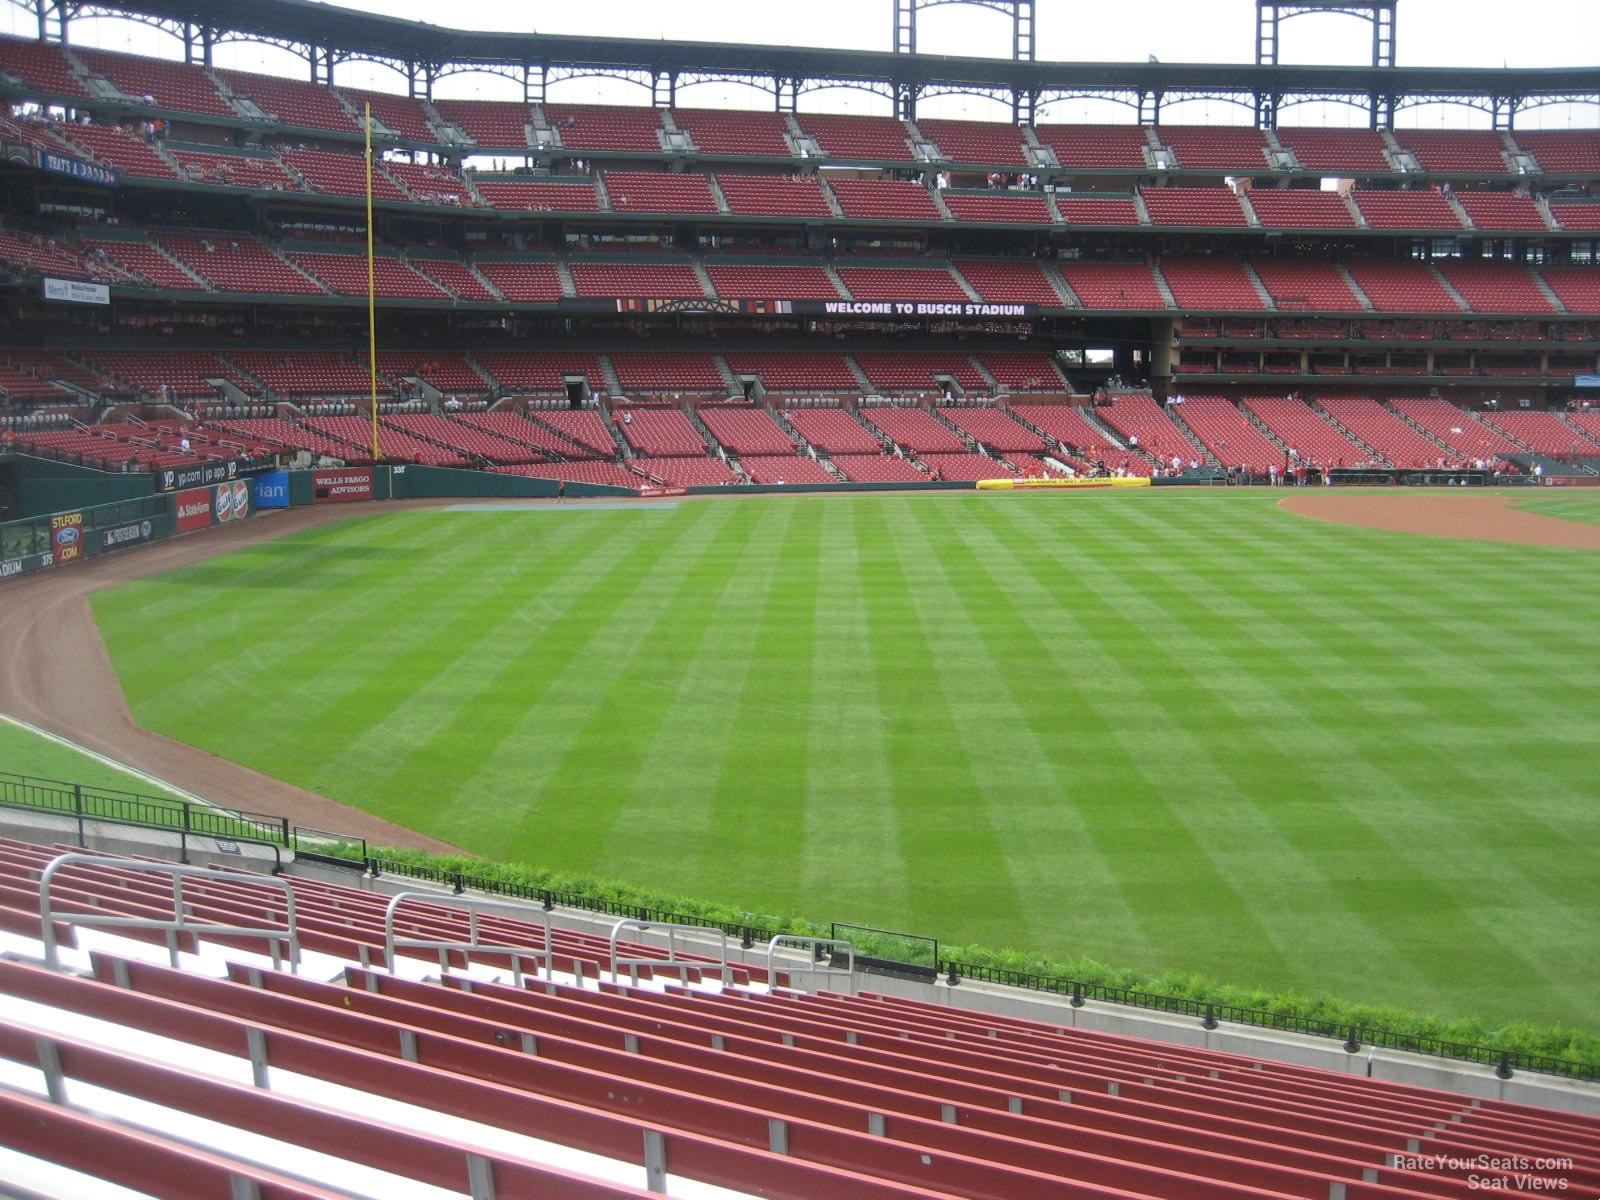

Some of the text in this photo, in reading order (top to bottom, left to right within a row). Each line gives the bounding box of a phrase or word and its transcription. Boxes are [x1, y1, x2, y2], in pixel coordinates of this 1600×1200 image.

[825, 302, 1025, 316] WELCOME TO BUSCH STADIUM
[227, 461, 237, 476] yp
[163, 470, 174, 487] yp
[178, 467, 225, 487] yp.com yp app
[316, 476, 370, 485] WELLS FARGO
[331, 485, 370, 494] ADVISORS
[216, 493, 231, 513] Gulf
[233, 491, 247, 510] Gulf
